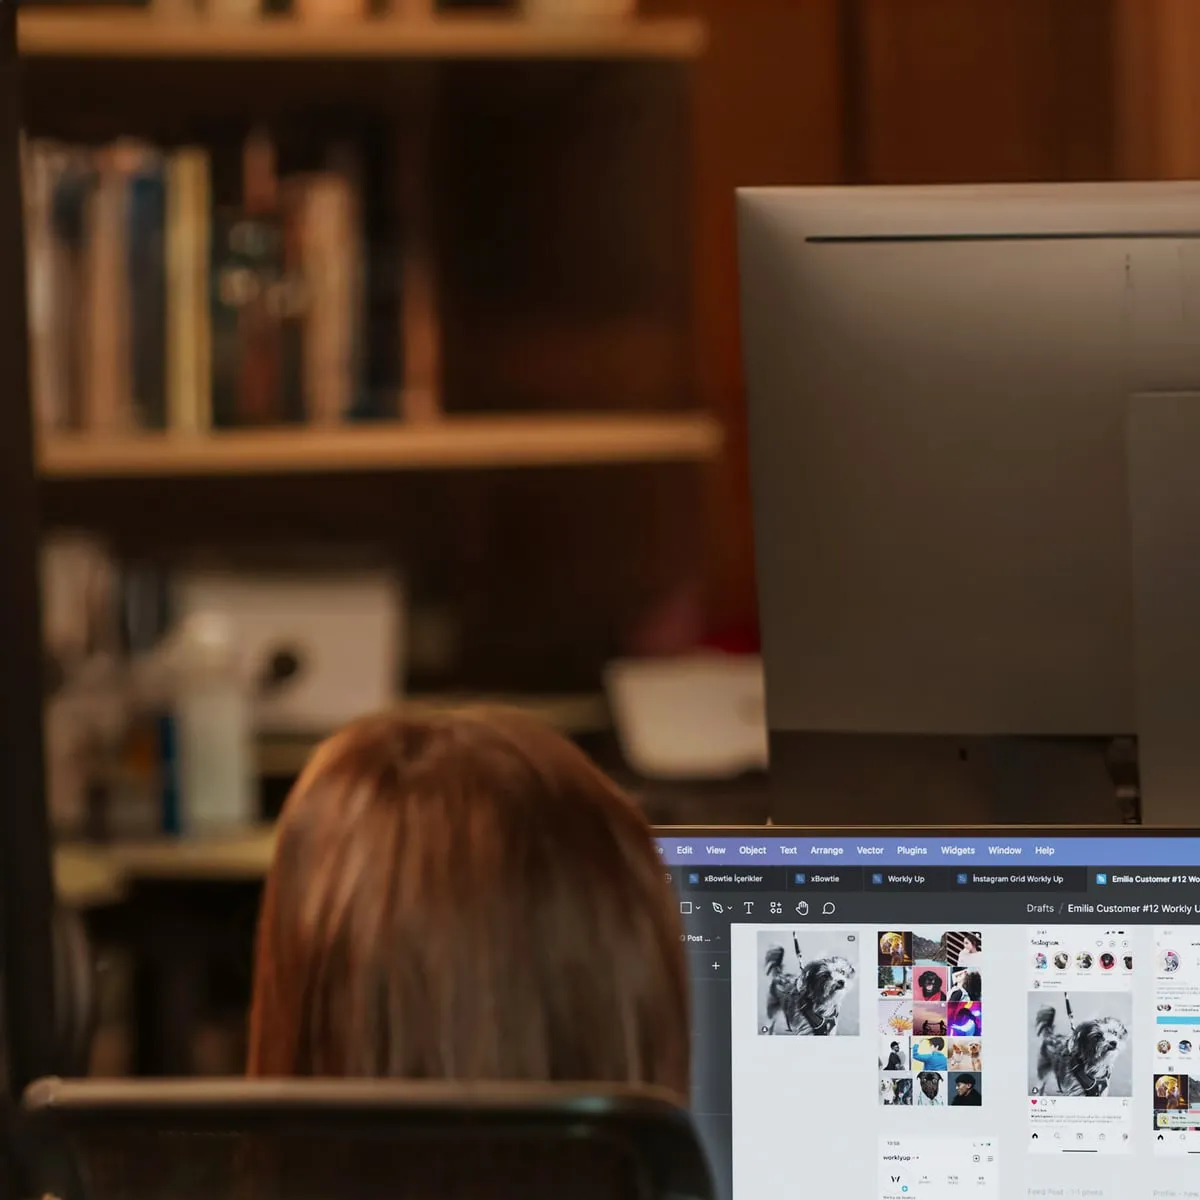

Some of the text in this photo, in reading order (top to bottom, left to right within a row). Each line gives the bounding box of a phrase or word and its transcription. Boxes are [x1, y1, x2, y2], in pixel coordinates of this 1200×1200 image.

[677, 846, 1055, 856] Edit View Object Text Arrange Vector Plugins Widgets Window Help
[887, 875, 925, 884] Workly Up
[1009, 875, 1025, 883] Grid
[1026, 875, 1051, 884] Workly
[1052, 875, 1064, 884] Up
[1112, 875, 1134, 883] Emilia
[1134, 875, 1171, 883] Customer
[1172, 875, 1187, 883] #12
[1026, 903, 1054, 913] Drafts
[1068, 903, 1094, 913] Emilia
[1096, 903, 1140, 913] Customer
[1142, 903, 1159, 913] #12
[1161, 903, 1193, 915] Workly
[687, 934, 703, 942] Post
[883, 1154, 911, 1162] worklyup
